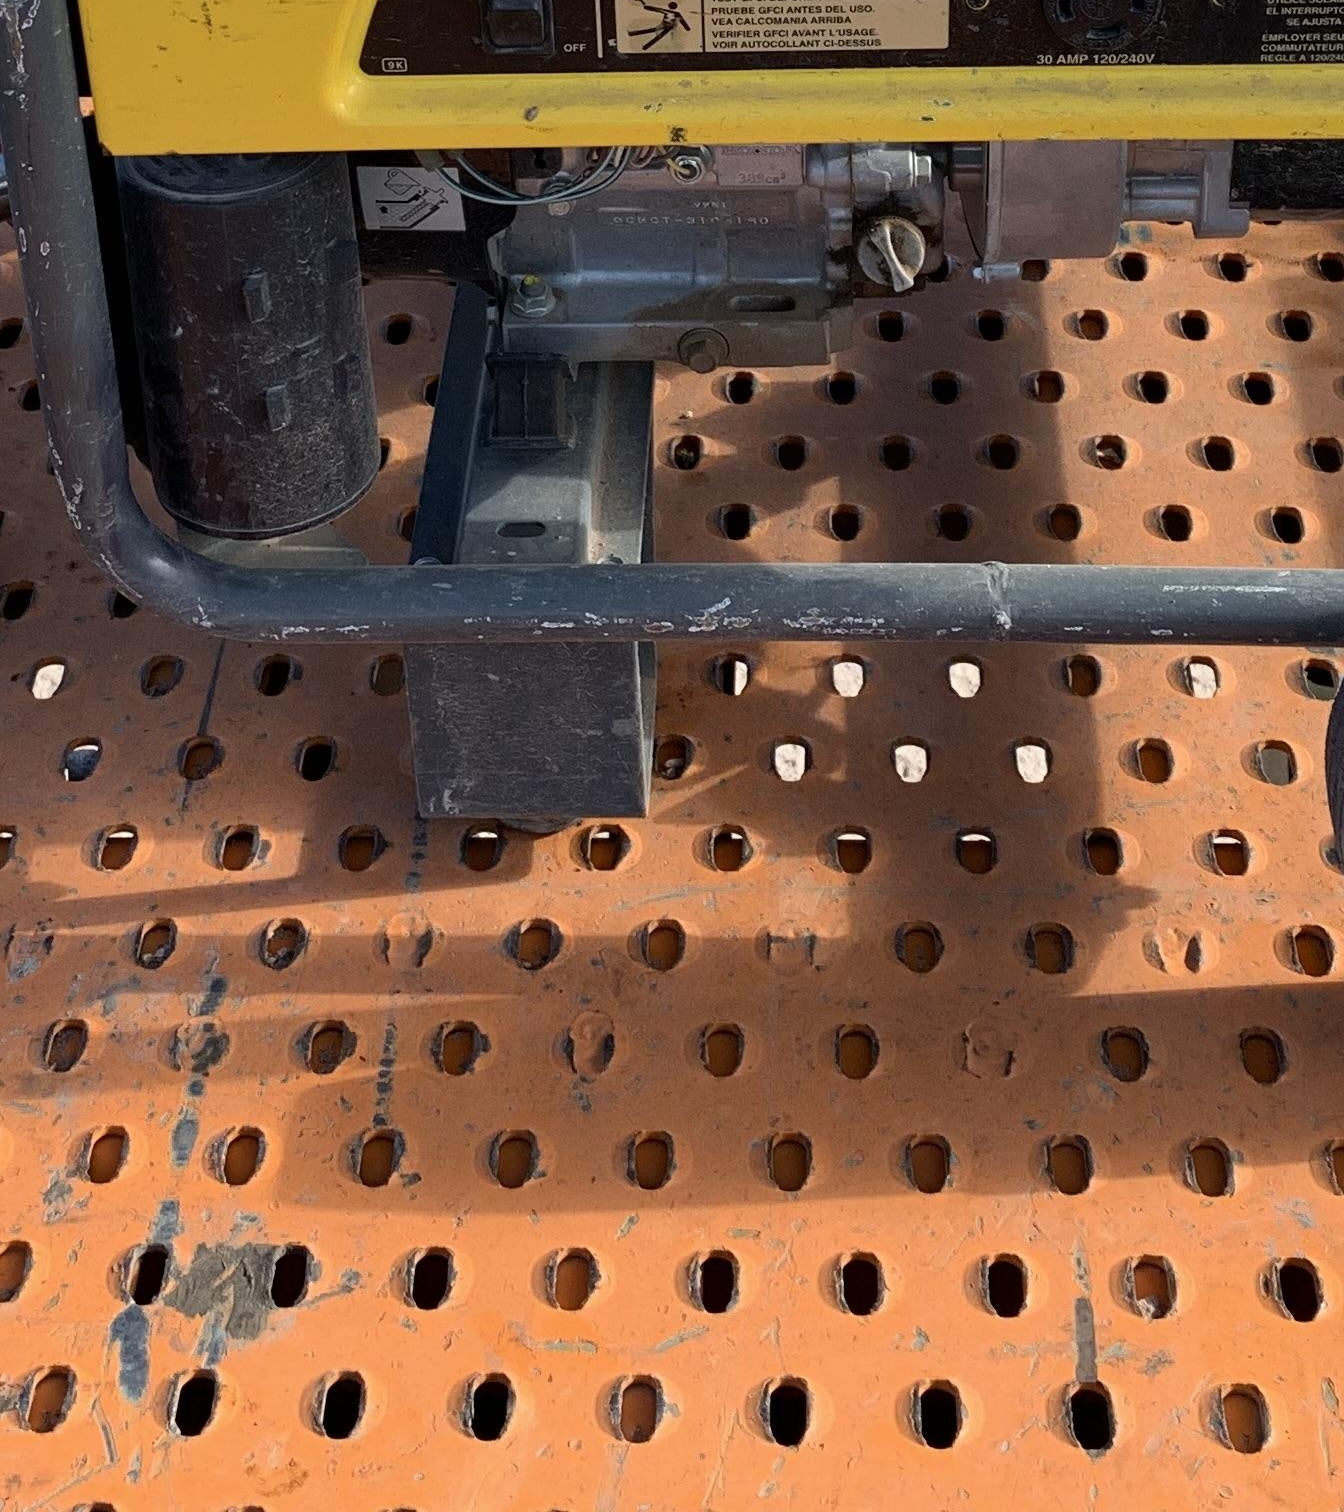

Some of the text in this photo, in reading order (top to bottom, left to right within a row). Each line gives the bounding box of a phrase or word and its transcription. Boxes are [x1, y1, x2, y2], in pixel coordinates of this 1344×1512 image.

[711, 7, 755, 15] PRUEBE
[758, 6, 784, 14] GFCI
[786, 5, 823, 14] ANTES
[825, 5, 847, 13] DEL
[711, 16, 852, 26] VEA CALCOMANIA ARRIBA
[1286, 18, 1300, 26] SE
[1302, 18, 1341, 26] AJUSTA
[712, 30, 761, 38] VERIFIER
[764, 29, 790, 37] GFCI
[791, 29, 826, 37] AVANT
[1262, 33, 1321, 42] EMPLOYER
[563, 44, 586, 52] OFF
[712, 39, 882, 48] VOIR AUTOCOLLANT CI-DESSUS
[1261, 44, 1344, 52] COMMUTATEUR
[1037, 54, 1155, 64] 30 AMP 120/240V
[1261, 54, 1296, 62] REGLE
